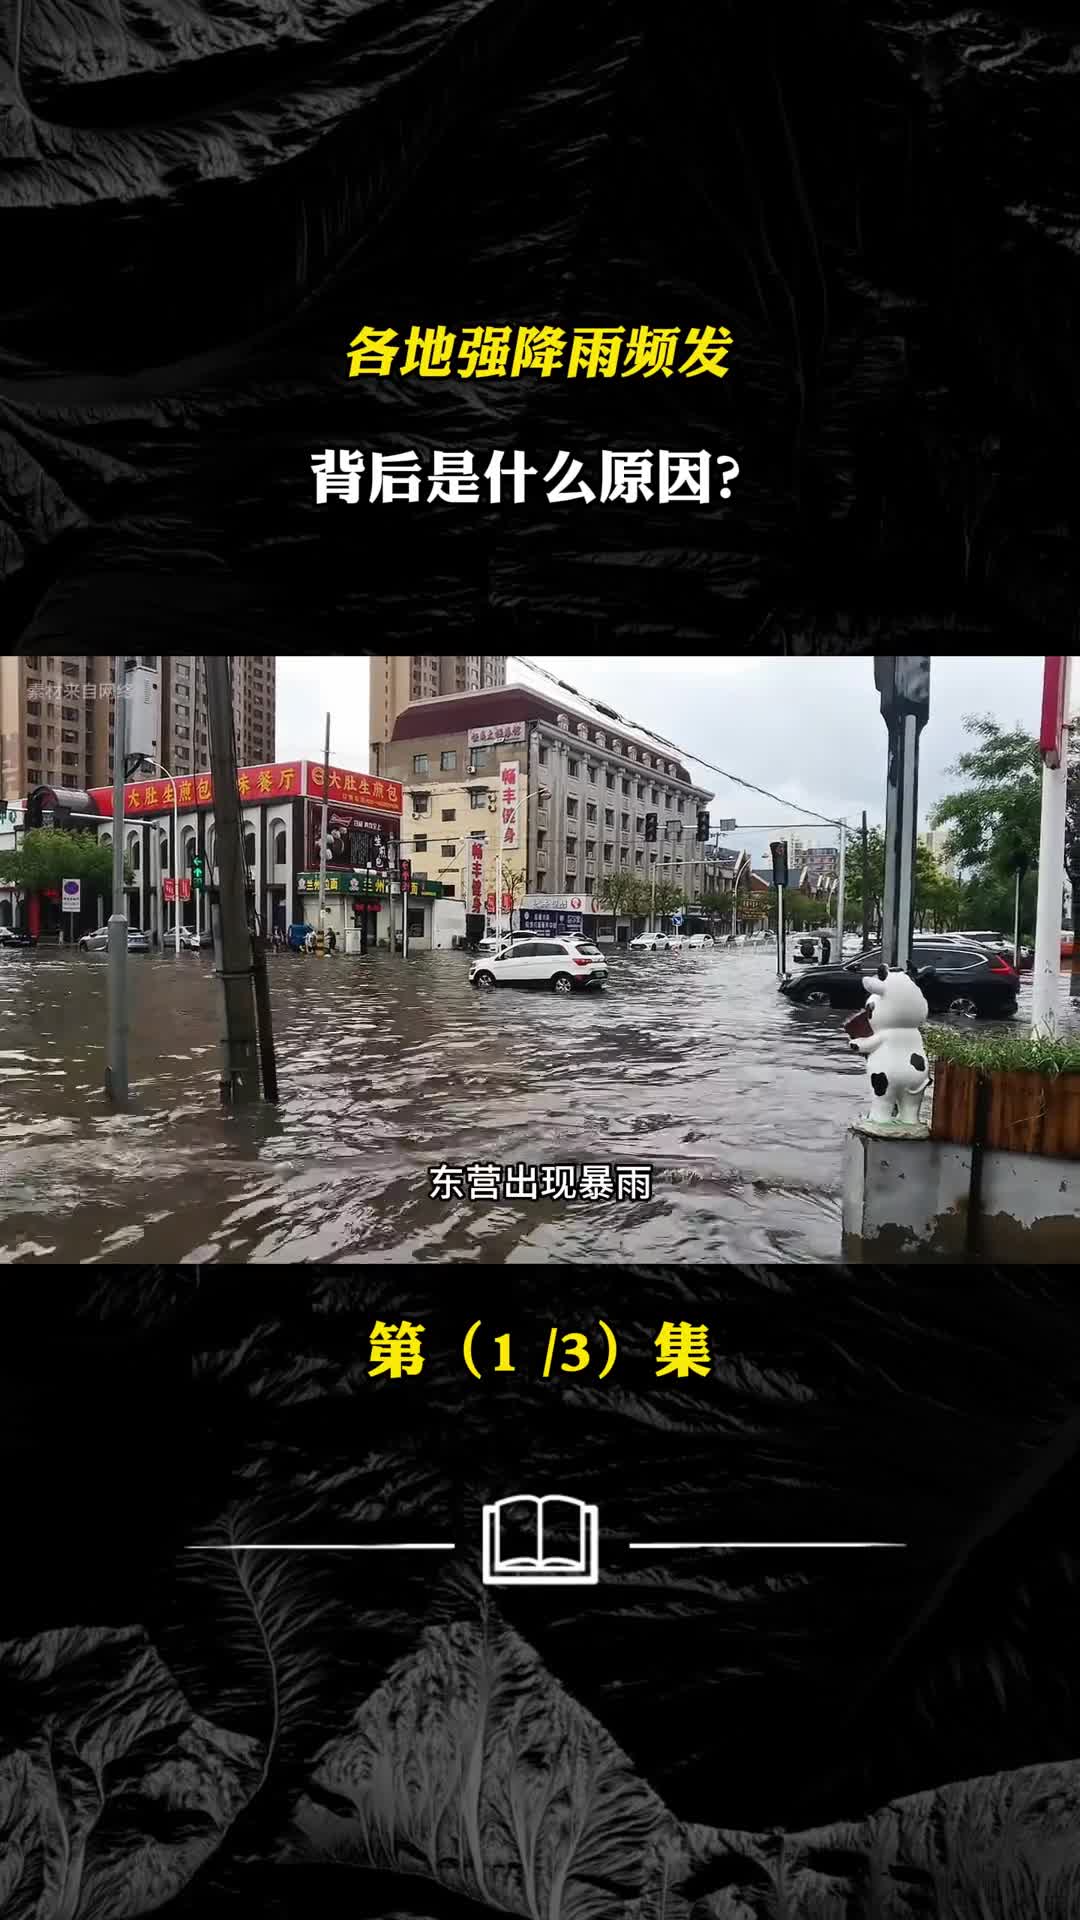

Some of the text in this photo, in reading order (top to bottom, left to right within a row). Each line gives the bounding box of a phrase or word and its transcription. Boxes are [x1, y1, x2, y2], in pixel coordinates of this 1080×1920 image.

[328, 770, 398, 802] 大肚生煎包
